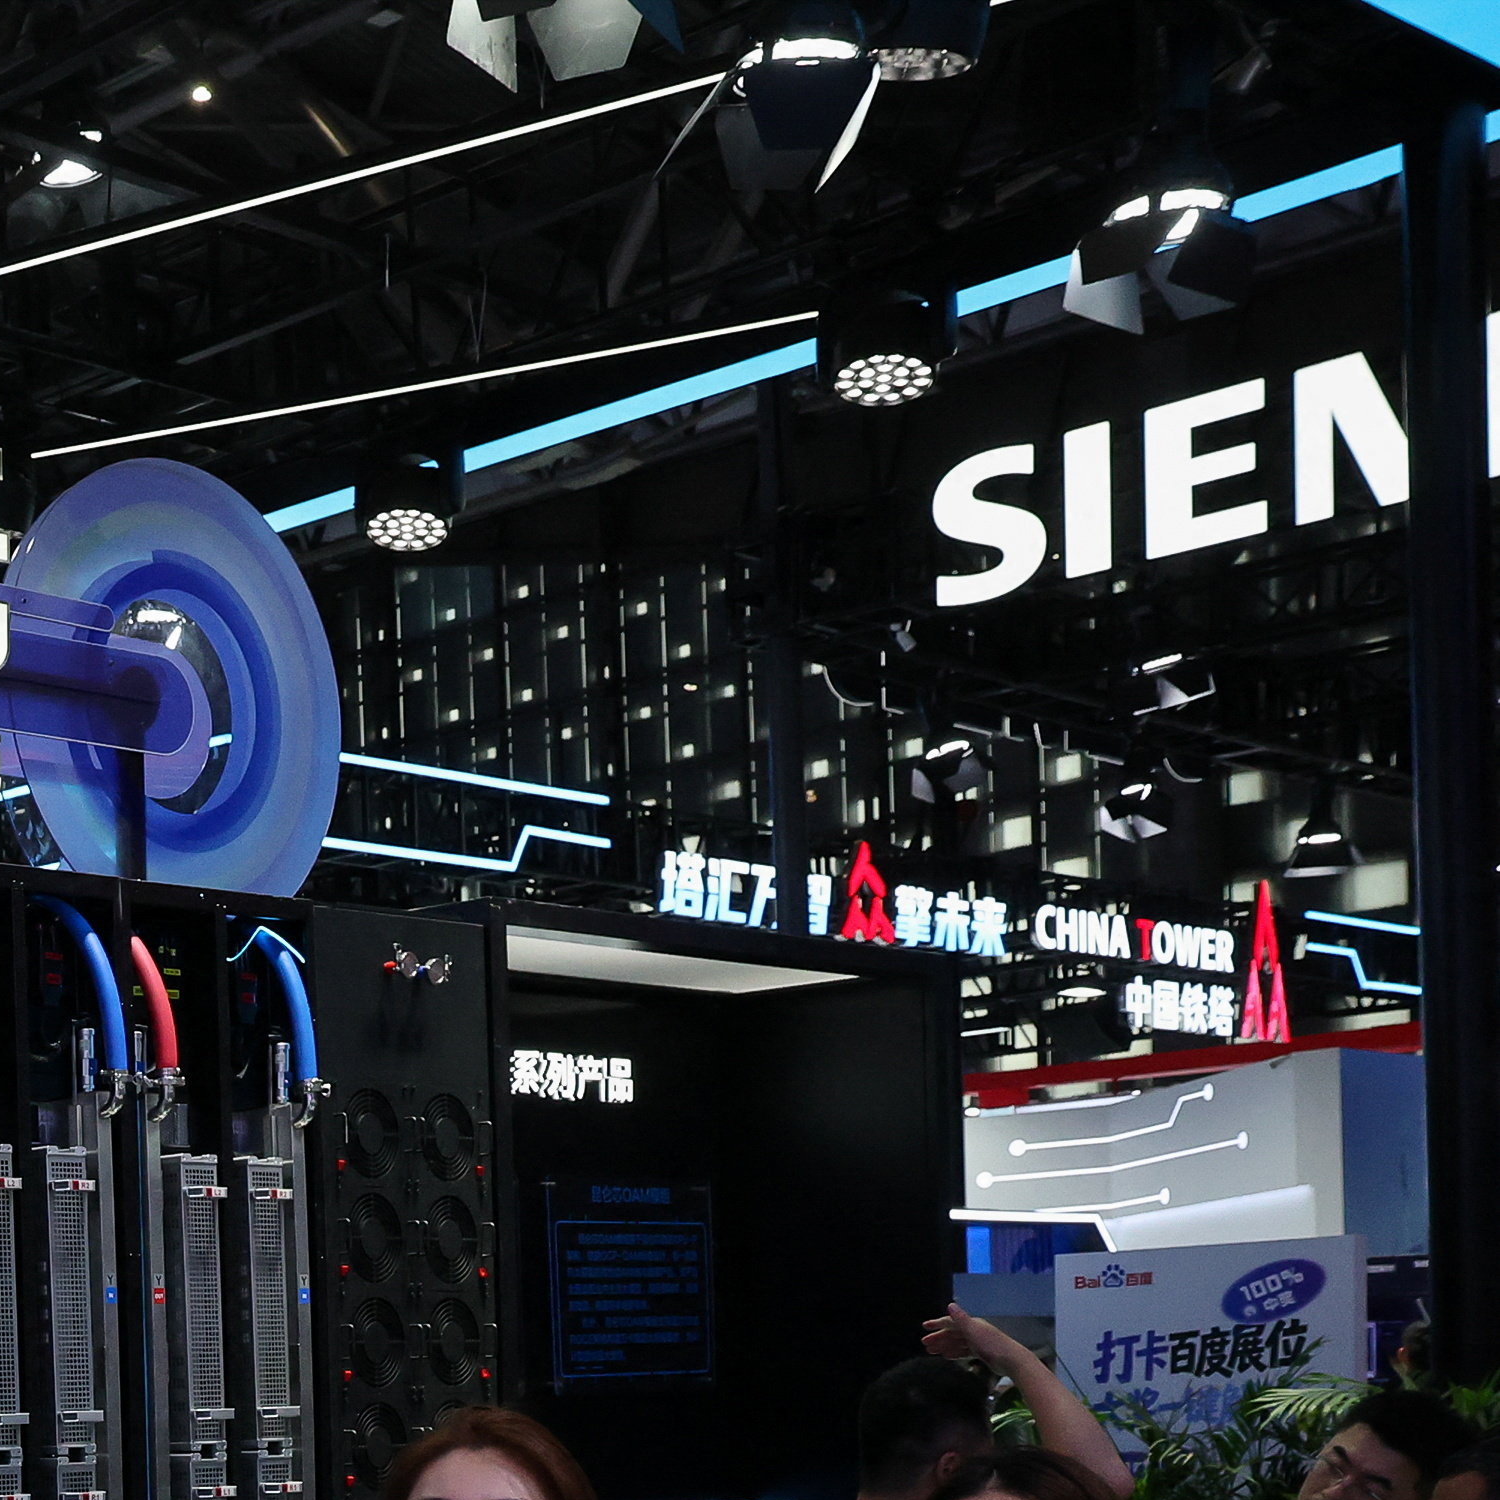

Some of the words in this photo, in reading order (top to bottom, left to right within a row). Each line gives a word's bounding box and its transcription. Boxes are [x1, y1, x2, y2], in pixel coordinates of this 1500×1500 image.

[1034, 903, 1131, 959] CHINA
[1136, 918, 1235, 974] TOWER
[1125, 975, 1235, 1037] 中国铁塔
[509, 1049, 635, 1104] 系列产品
[7, 1179, 15, 1187] L2
[107, 1274, 113, 1285] Y
[155, 1274, 162, 1285] Y
[301, 1275, 307, 1286] Y
[1074, 1275, 1102, 1289] Bai
[1239, 1267, 1304, 1301] 100%
[1092, 1318, 1309, 1385] 打卡百度展位
